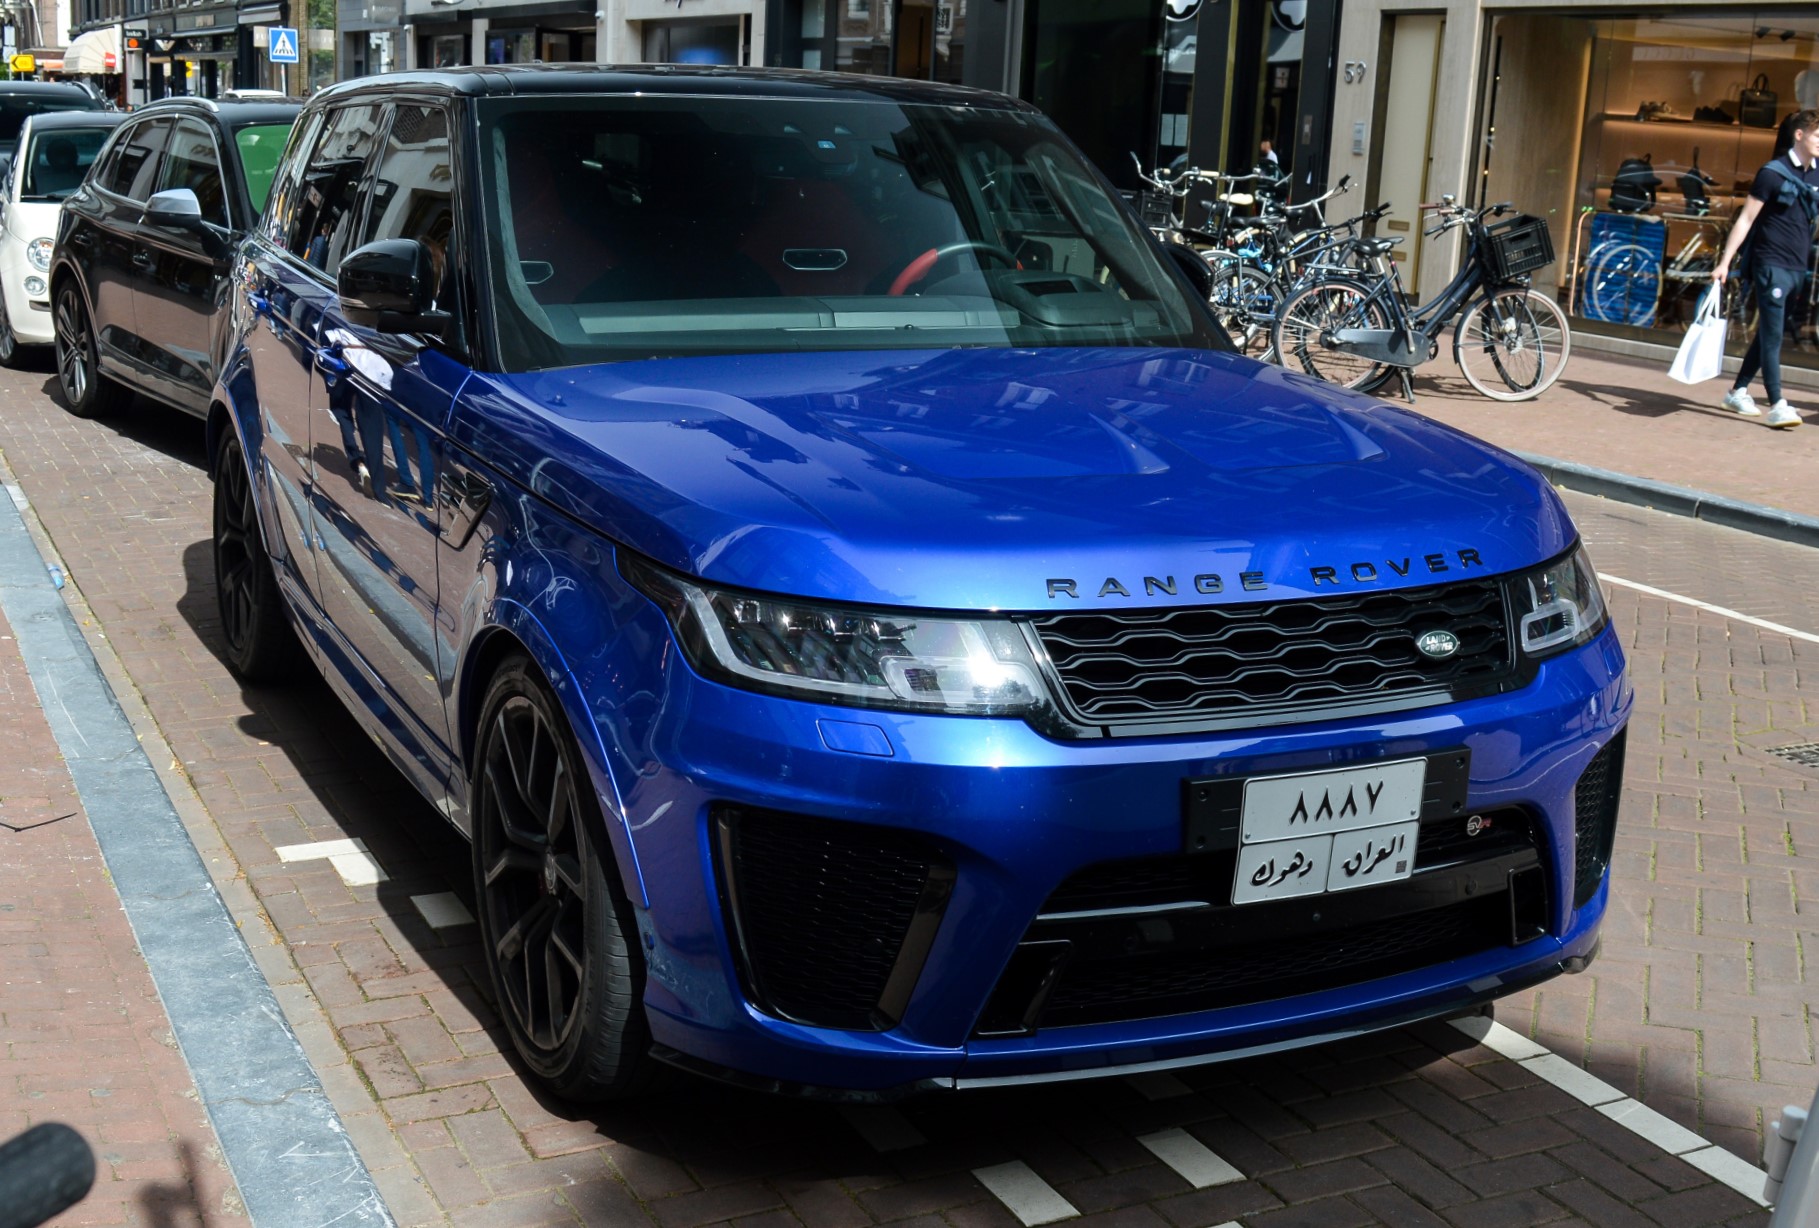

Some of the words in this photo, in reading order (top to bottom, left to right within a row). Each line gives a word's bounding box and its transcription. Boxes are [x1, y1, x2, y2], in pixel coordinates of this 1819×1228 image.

[1344, 60, 1367, 84] 59
[1046, 570, 1269, 599] RANGE
[1311, 547, 1484, 586] ROVER
[1426, 635, 1446, 645] LAND
[1429, 642, 1454, 653] ROVER
[1289, 781, 1384, 826] ٨٨٨٧
[1342, 833, 1405, 877] العراق
